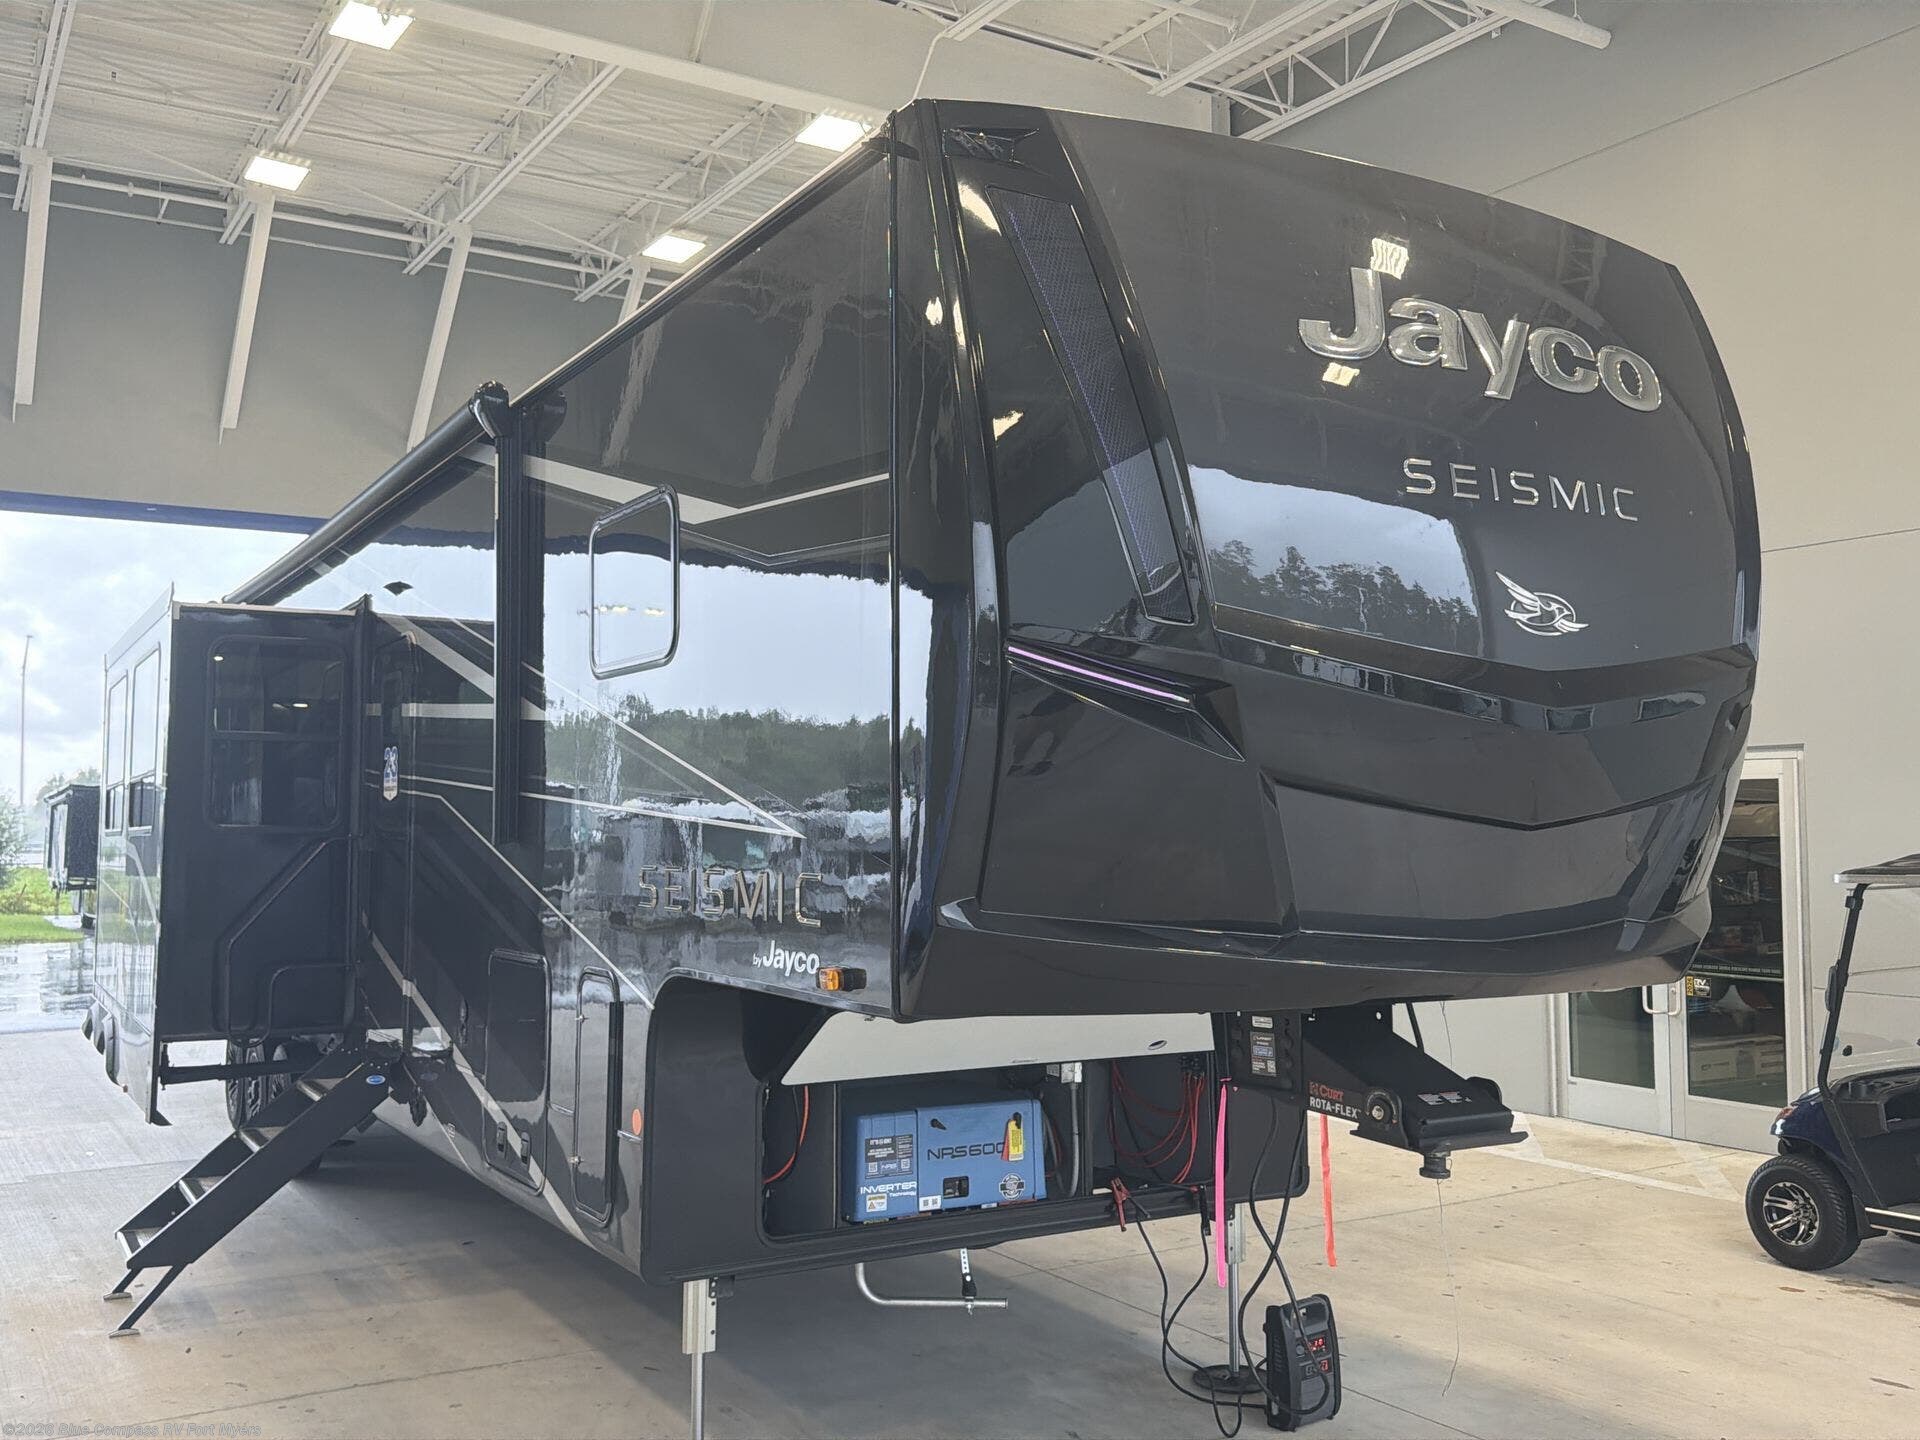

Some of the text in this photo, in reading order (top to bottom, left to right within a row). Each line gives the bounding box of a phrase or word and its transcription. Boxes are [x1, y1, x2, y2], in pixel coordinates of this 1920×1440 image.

[1299, 267, 1662, 413] Jayco
[1403, 457, 1639, 522] SEISMIC
[638, 865, 823, 928] SEISMIC
[752, 940, 820, 977] by Jayco
[1319, 1084, 1344, 1102] CURT
[860, 1181, 918, 1195] INVERTER
